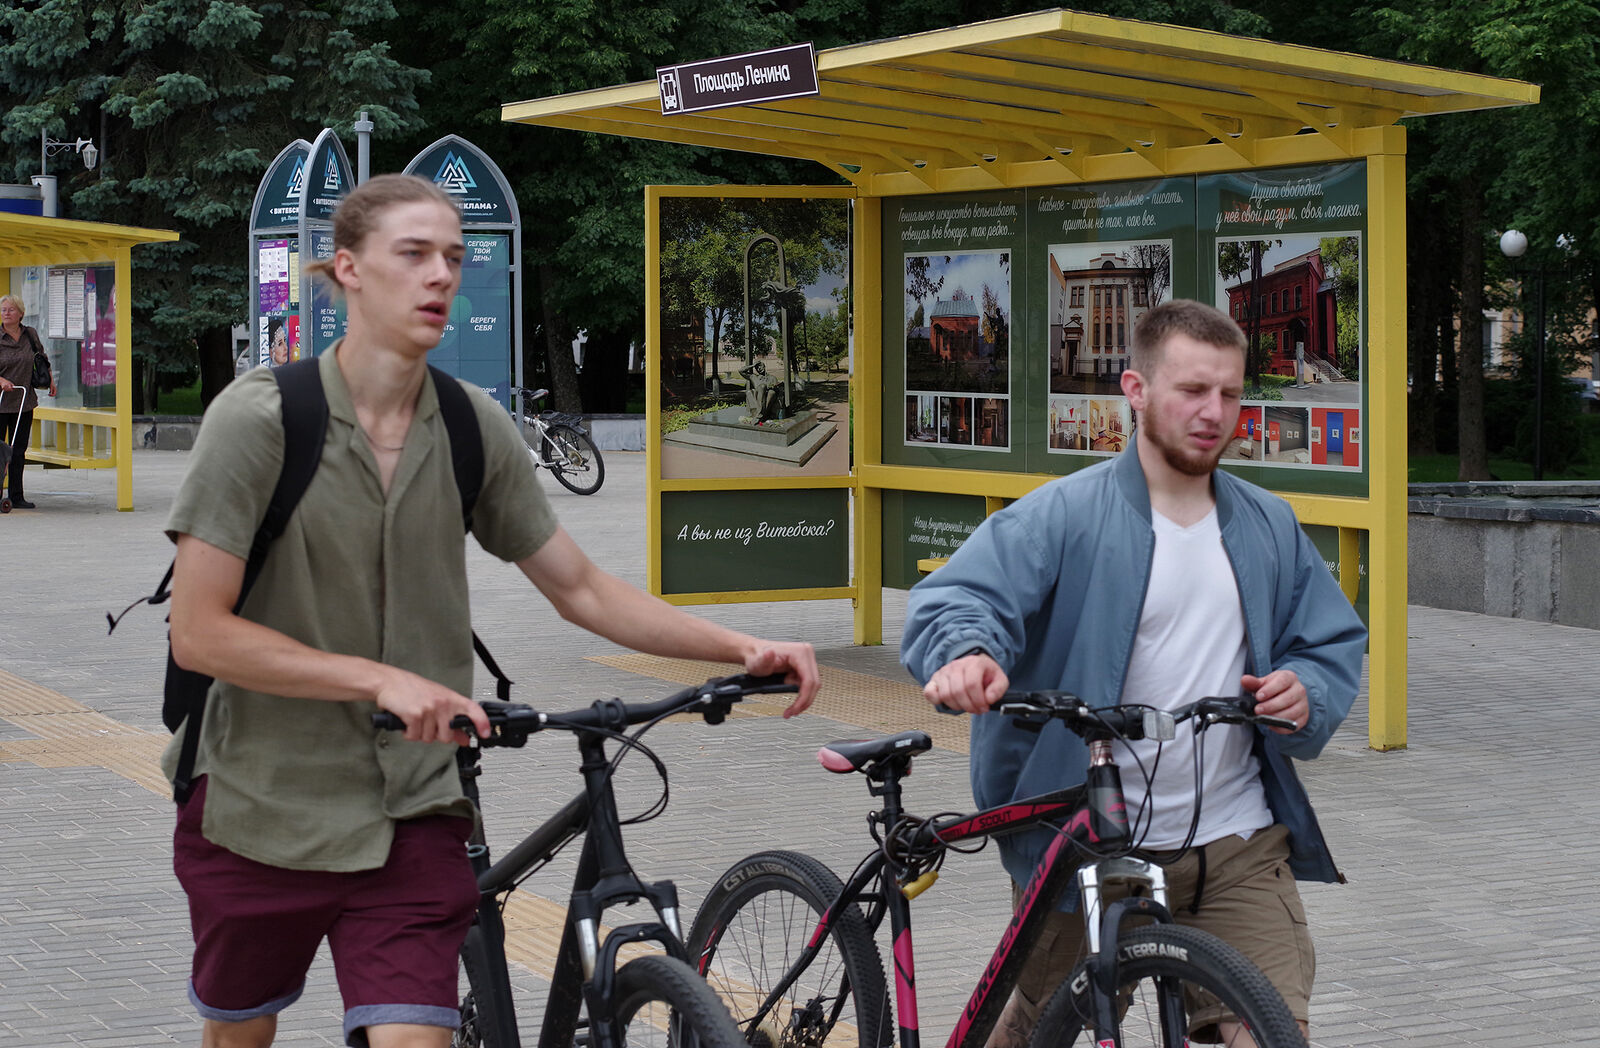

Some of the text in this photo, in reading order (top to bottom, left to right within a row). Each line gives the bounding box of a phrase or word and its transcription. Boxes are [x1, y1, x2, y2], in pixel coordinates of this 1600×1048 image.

[693, 64, 790, 94] Площадь Ленина
[1038, 196, 1065, 212] Главное
[1071, 192, 1112, 216] искусство,
[1114, 190, 1144, 207] главное
[1151, 192, 1183, 205] писать,
[1249, 178, 1323, 209] Душа свободна,
[899, 208, 935, 222] Гениальное
[936, 203, 972, 224] искусство
[1062, 215, 1094, 234] притом
[1095, 216, 1104, 228] не
[1105, 217, 1123, 229] так,
[1125, 213, 1140, 227] как
[1215, 210, 1223, 232] у
[1224, 208, 1240, 223] неё
[1262, 208, 1297, 229] разум,
[1301, 201, 1322, 219] своя
[1324, 203, 1362, 217] логика.
[467, 241, 498, 249] СЕГОДНЯ
[901, 226, 930, 245] освещая
[931, 224, 943, 239] всё
[944, 221, 969, 246] вокруг,
[971, 226, 987, 237] так
[472, 254, 492, 262] ДЕНЬ!
[474, 247, 491, 255] ТВОЙ
[677, 519, 835, 545] А вы не из Витебска?
[978, 810, 1013, 829] SCOUT
[722, 870, 746, 891] CST
[745, 863, 763, 877] ALL
[1124, 942, 1188, 962] TERRAINS
[1071, 970, 1088, 995] CS
